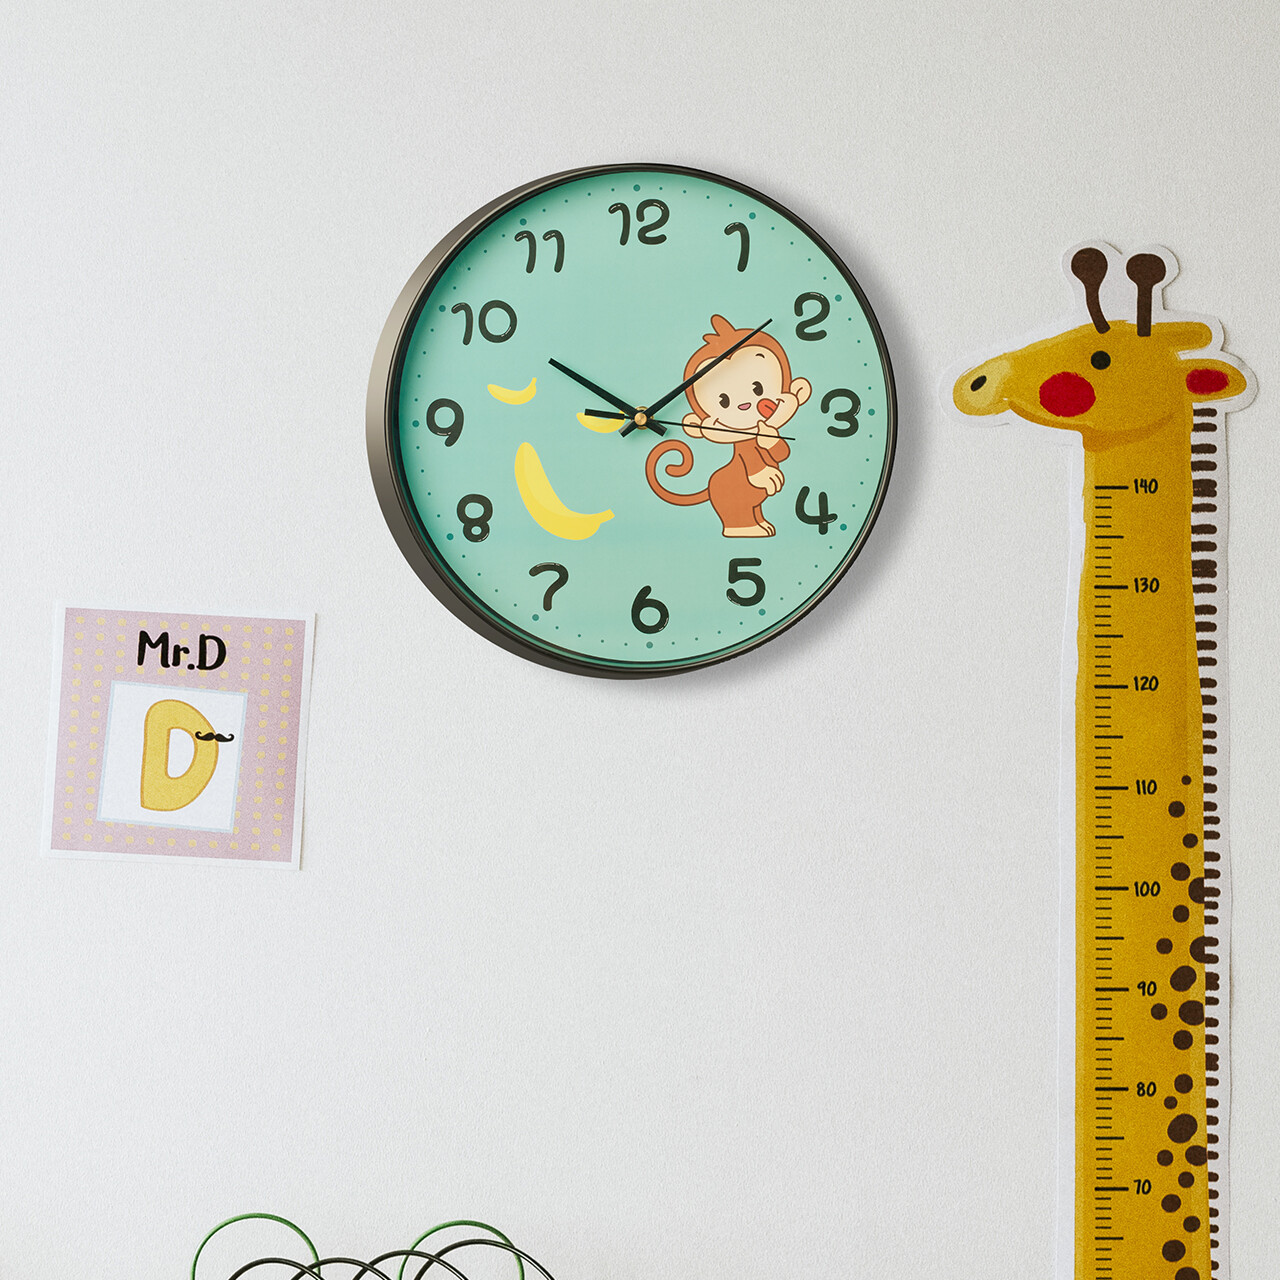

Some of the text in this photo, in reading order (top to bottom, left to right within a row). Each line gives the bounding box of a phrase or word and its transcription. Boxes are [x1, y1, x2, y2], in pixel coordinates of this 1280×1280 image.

[608, 199, 669, 245] 12
[515, 230, 564, 273] 11
[724, 222, 749, 272] 1
[451, 300, 517, 345] 10
[794, 292, 830, 341] 2
[426, 398, 464, 447] 9
[821, 389, 861, 437] 3
[1134, 479, 1158, 494] 140
[457, 494, 493, 542] 8
[795, 486, 838, 535] 4
[529, 563, 568, 611] 7
[727, 558, 765, 606] 5
[1134, 578, 1159, 593] 130
[631, 586, 669, 634] 6
[138, 631, 226, 670] Mr.D
[1134, 676, 1159, 691] 120
[140, 699, 219, 812] D
[1136, 780, 1157, 795] 110
[1134, 881, 1160, 896] 100
[1137, 981, 1157, 996] 90
[1137, 1082, 1156, 1096] 80
[1134, 1179, 1151, 1194] 70
